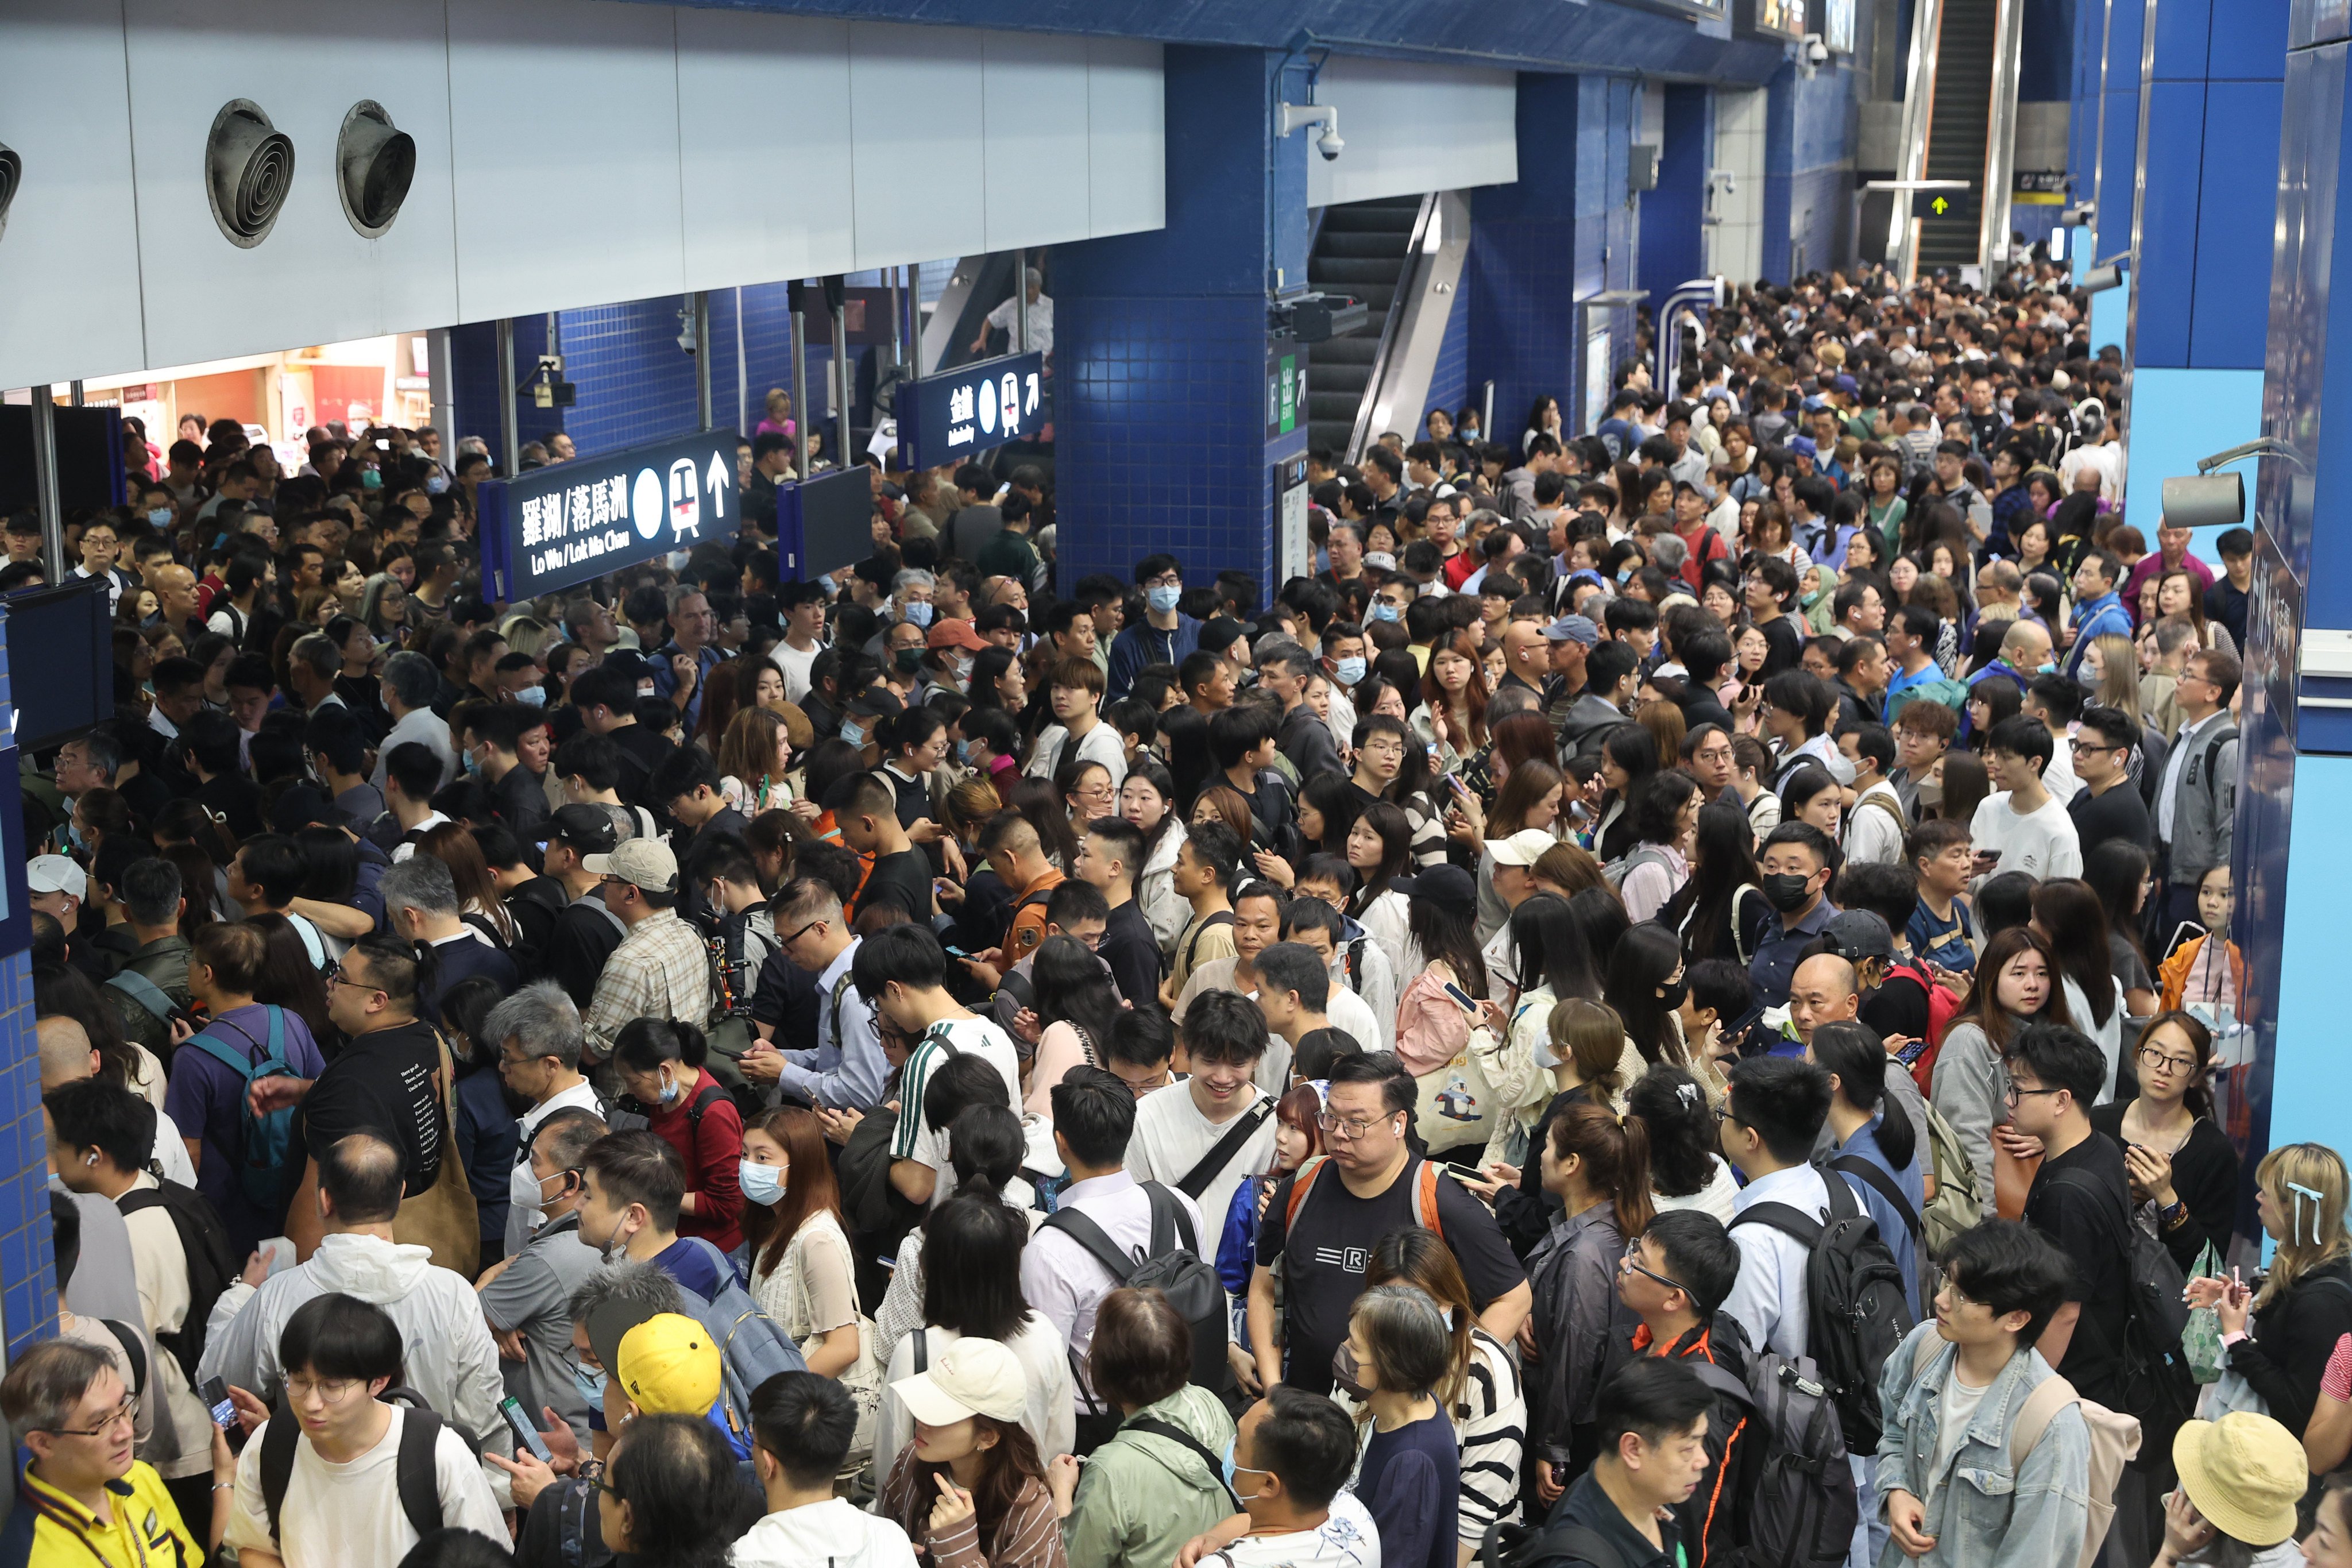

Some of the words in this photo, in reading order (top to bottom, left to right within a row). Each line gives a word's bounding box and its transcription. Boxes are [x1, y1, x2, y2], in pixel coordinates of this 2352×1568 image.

[1282, 367, 1292, 405] 出
[1270, 382, 1276, 416] F
[1282, 404, 1292, 420] EXIT
[531, 554, 545, 576] Lo
[544, 547, 563, 571] Wu
[569, 539, 588, 563] Lok
[588, 535, 604, 558] Ma
[604, 530, 630, 552] Chau
[404, 1076, 416, 1084] Three,
[408, 1084, 418, 1092] Uncle
[415, 1108, 423, 1116] Ever
[1350, 1251, 1361, 1266] R
